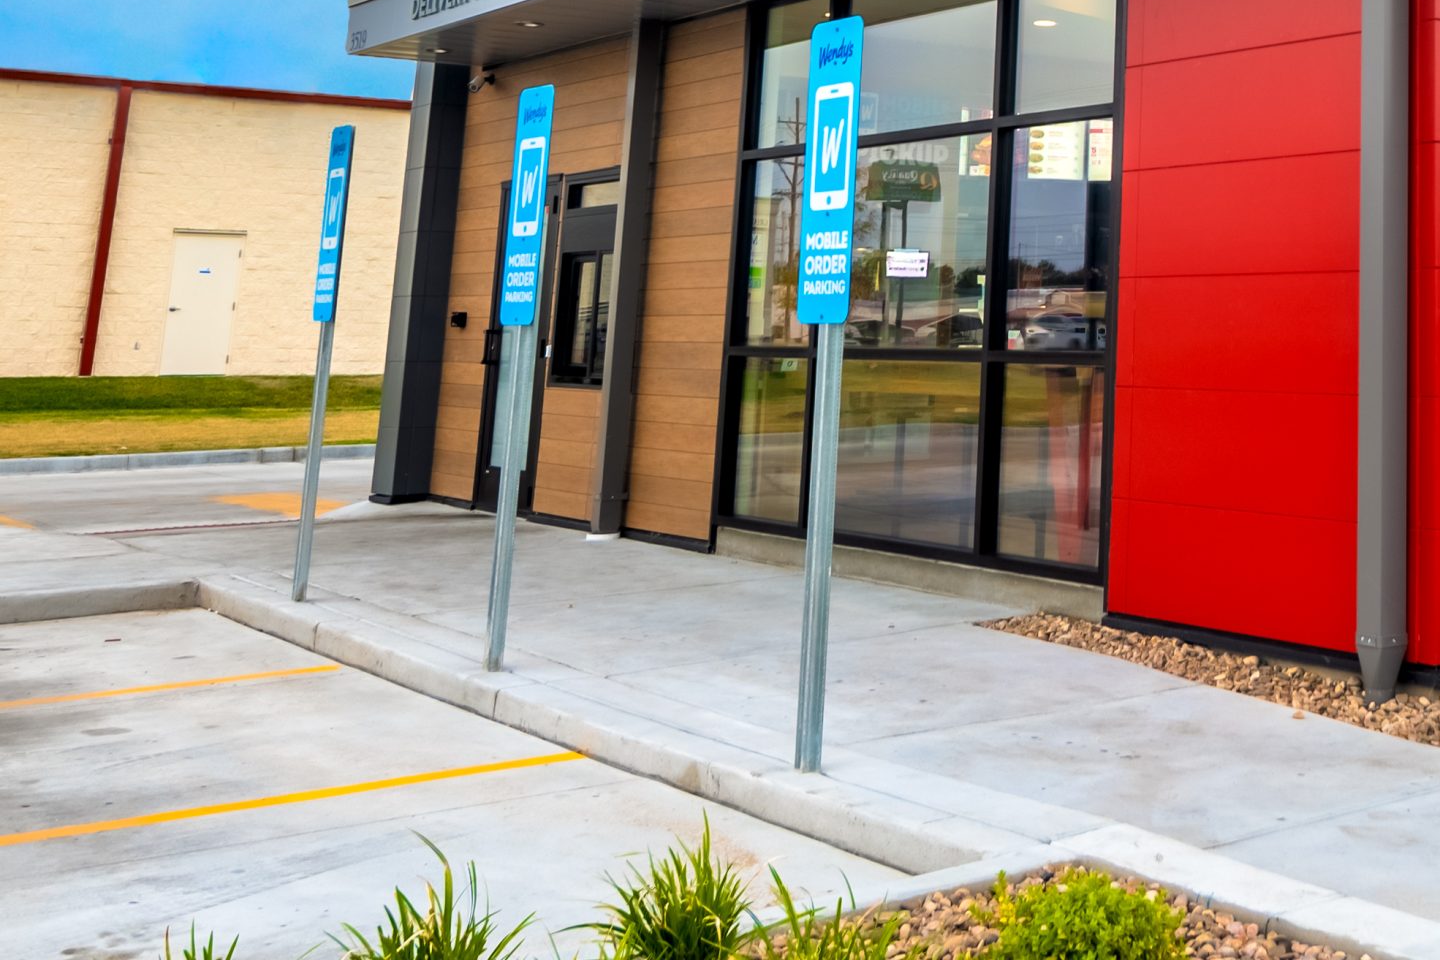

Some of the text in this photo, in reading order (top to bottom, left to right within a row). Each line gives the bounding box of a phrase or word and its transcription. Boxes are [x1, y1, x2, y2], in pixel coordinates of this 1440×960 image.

[818, 37, 854, 70] Wendy's
[821, 118, 845, 175] W
[521, 165, 539, 209] W
[805, 230, 848, 250] MOBILE
[508, 252, 537, 268] MOBILE
[804, 254, 846, 275] ORDER
[506, 271, 535, 287] ORDER
[803, 278, 846, 296] PARKING
[504, 289, 533, 303] PARKING
